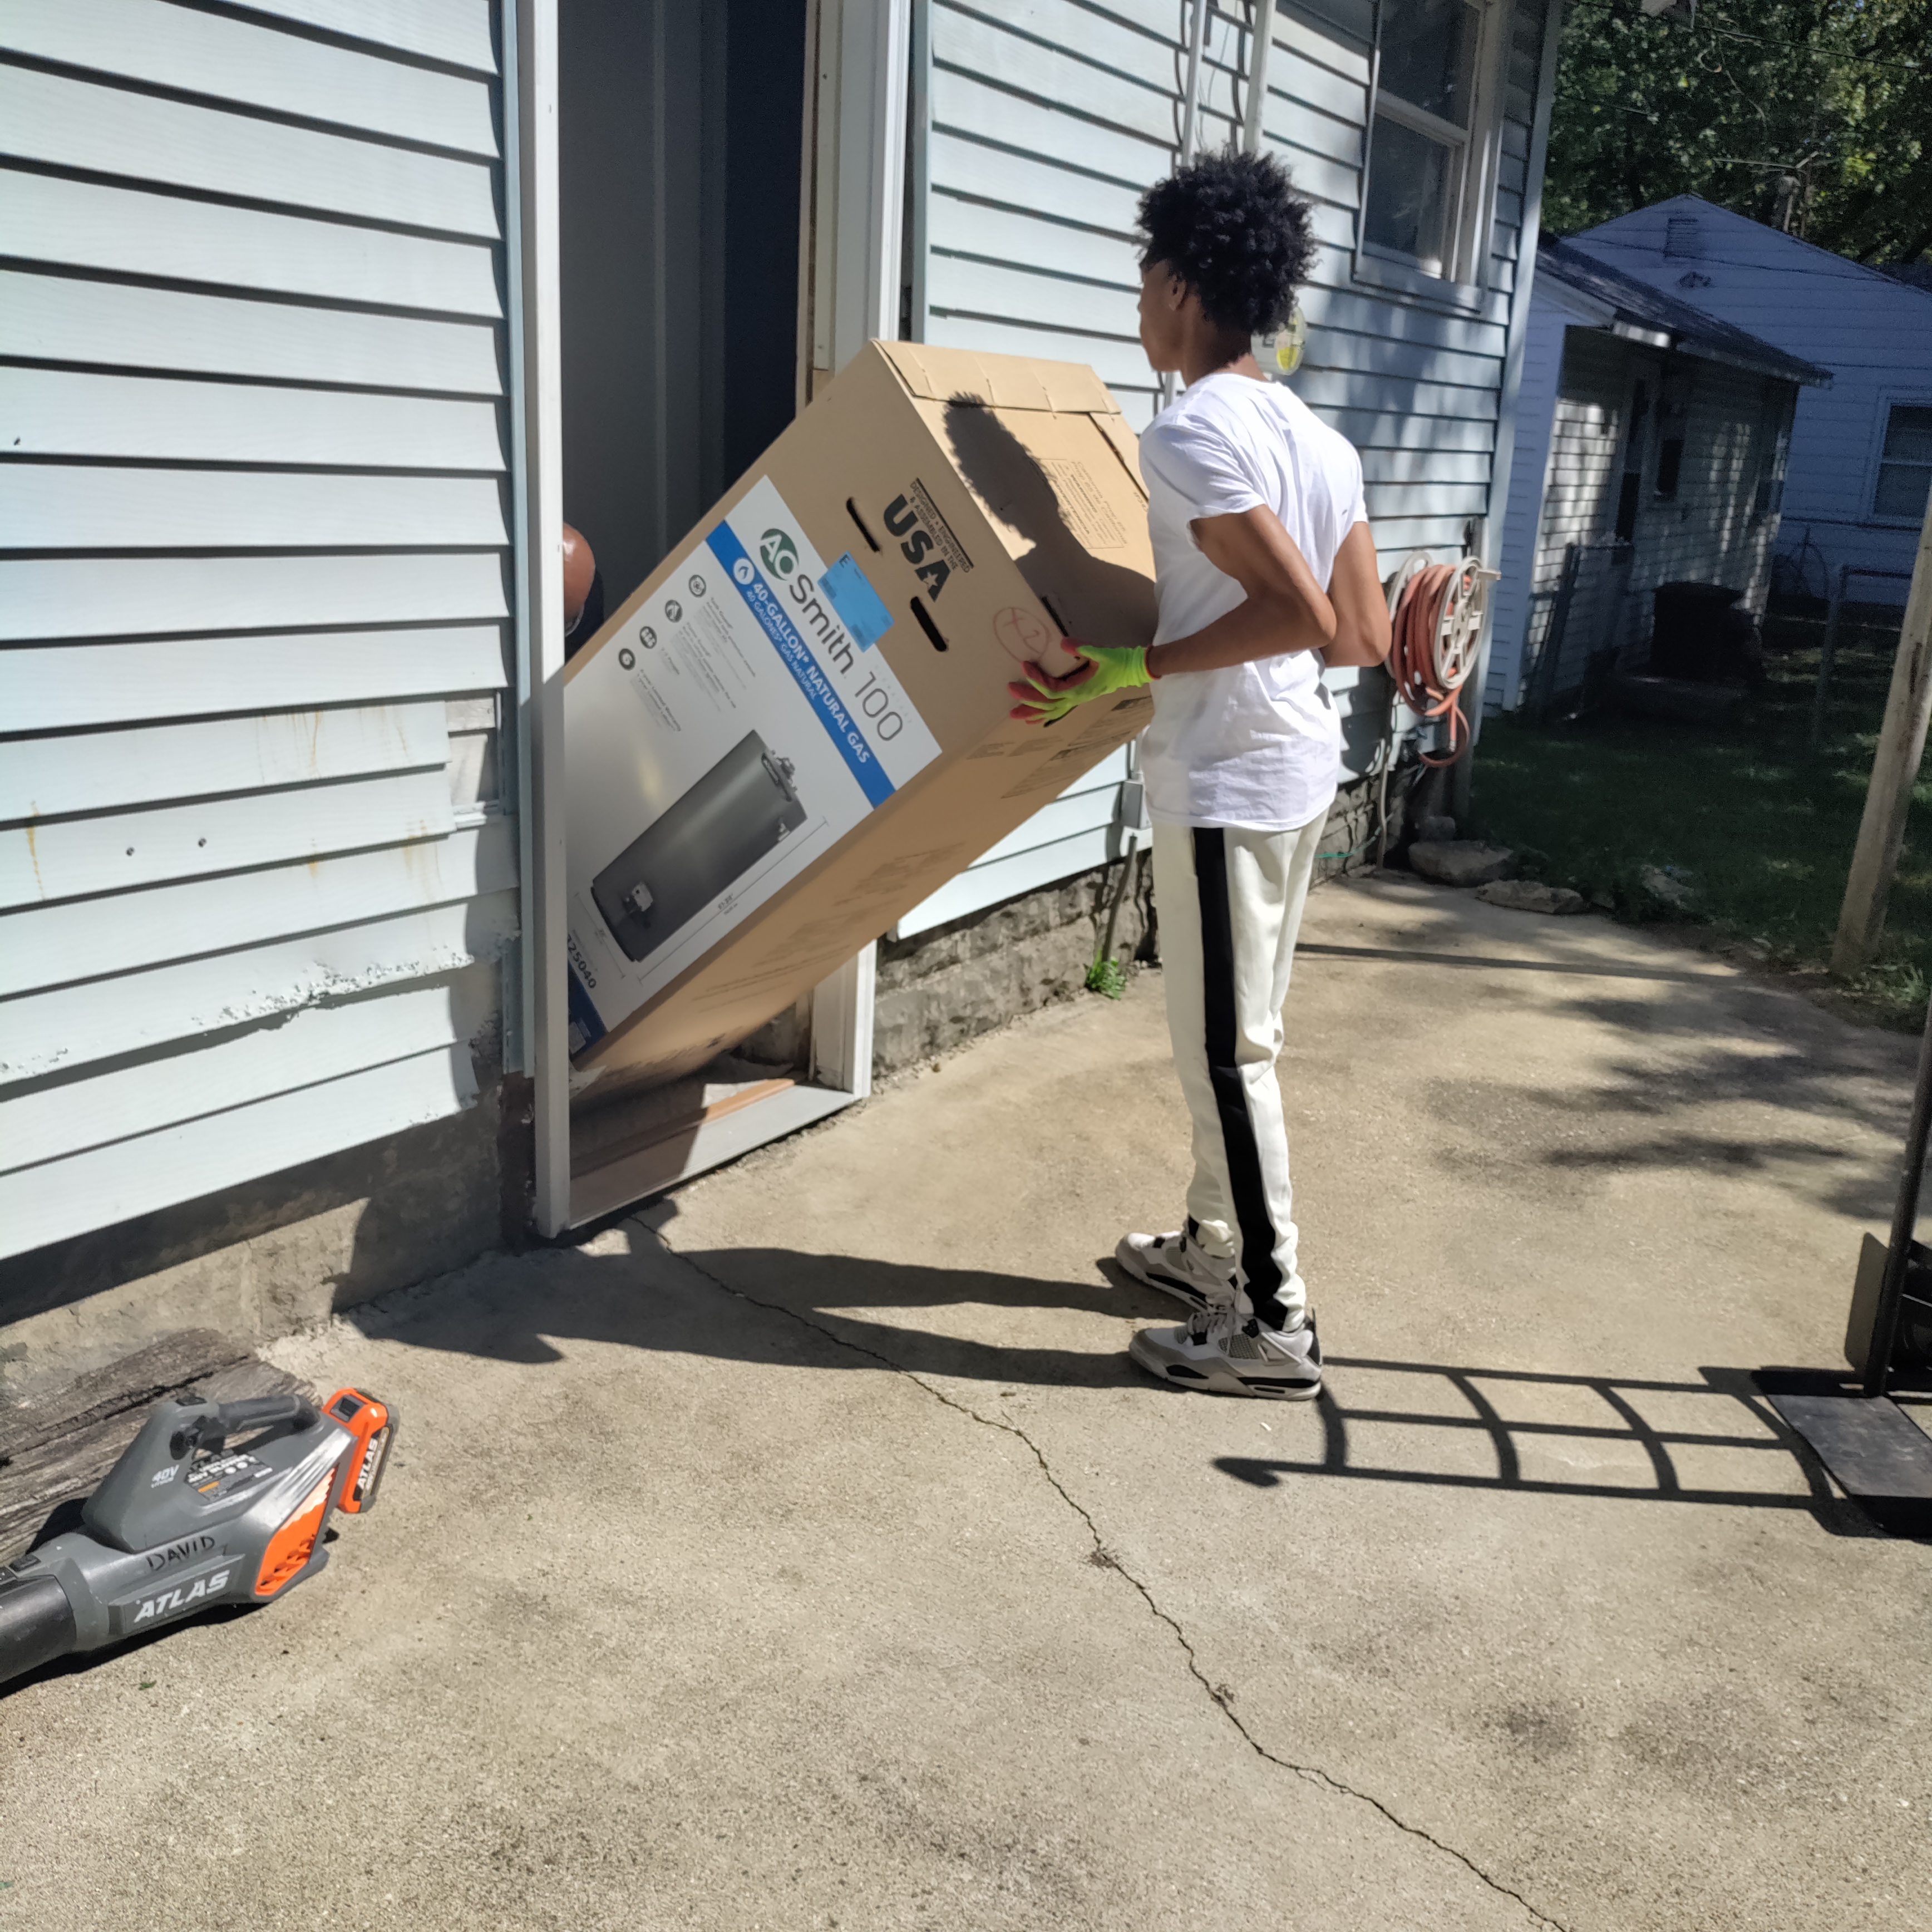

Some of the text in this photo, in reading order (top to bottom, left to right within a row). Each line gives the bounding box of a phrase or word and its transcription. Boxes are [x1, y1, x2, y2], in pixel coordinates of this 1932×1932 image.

[883, 493, 952, 603] USA
[910, 481, 970, 573] DESIGNED ENGINEERED
[914, 504, 944, 546] ASSEMBLED
[947, 555, 959, 571] THE
[781, 643, 795, 662] GAS
[791, 660, 817, 700] NATURAL
[789, 574, 854, 676] Smith
[854, 671, 903, 742] 100
[806, 666, 847, 733] NATURAL
[846, 732, 870, 763] GAS
[152, 1464, 180, 1482] 40V
[357, 1438, 378, 1490] ATLAS
[145, 1535, 216, 1571] DAVID
[133, 1569, 230, 1623] ATLAS
